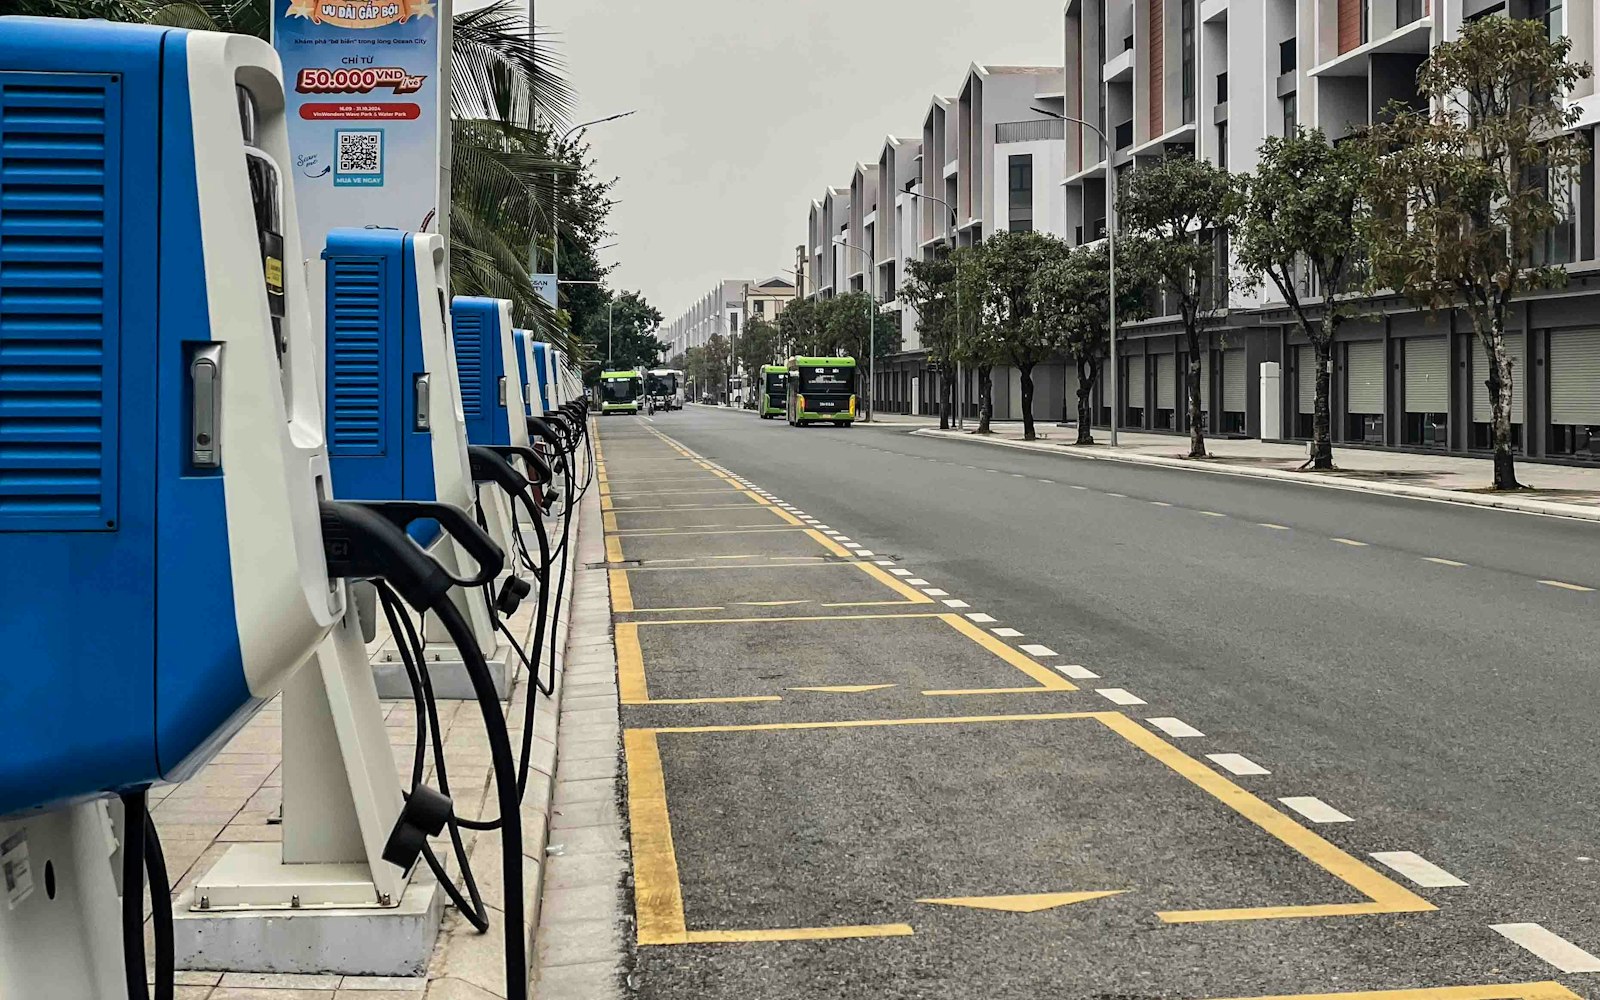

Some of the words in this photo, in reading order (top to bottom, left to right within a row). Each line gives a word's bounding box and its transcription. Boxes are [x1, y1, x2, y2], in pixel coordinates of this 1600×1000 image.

[322, 4, 336, 17] ƯU
[338, 4, 356, 19] ĐÃI
[359, 1, 379, 20] GẤP
[382, 3, 398, 18] BỘI
[341, 54, 359, 64] CHỈ
[361, 55, 374, 64] TỪ
